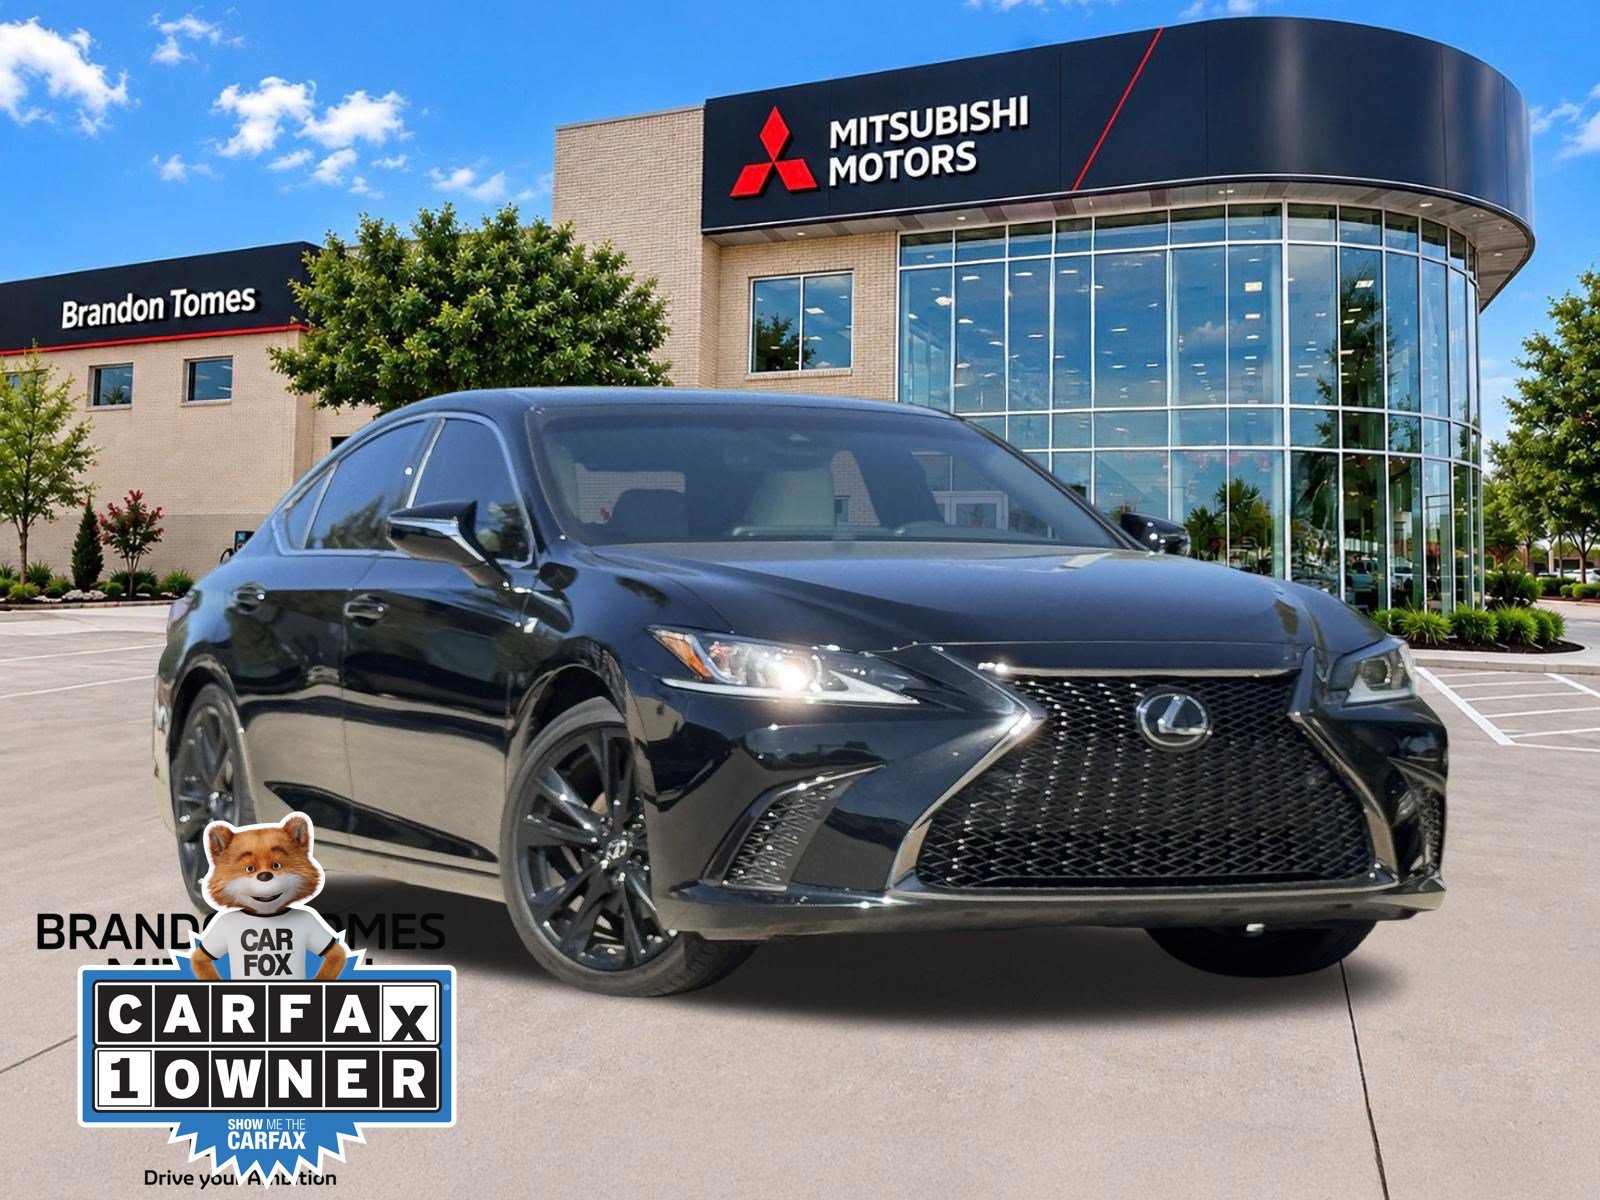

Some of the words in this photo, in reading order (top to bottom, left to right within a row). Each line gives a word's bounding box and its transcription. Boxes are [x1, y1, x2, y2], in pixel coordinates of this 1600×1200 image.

[829, 95, 1029, 149] MITSUBISHI
[829, 141, 977, 187] MOTORS
[61, 293, 165, 329] Brandon
[170, 288, 256, 319] Tomes
